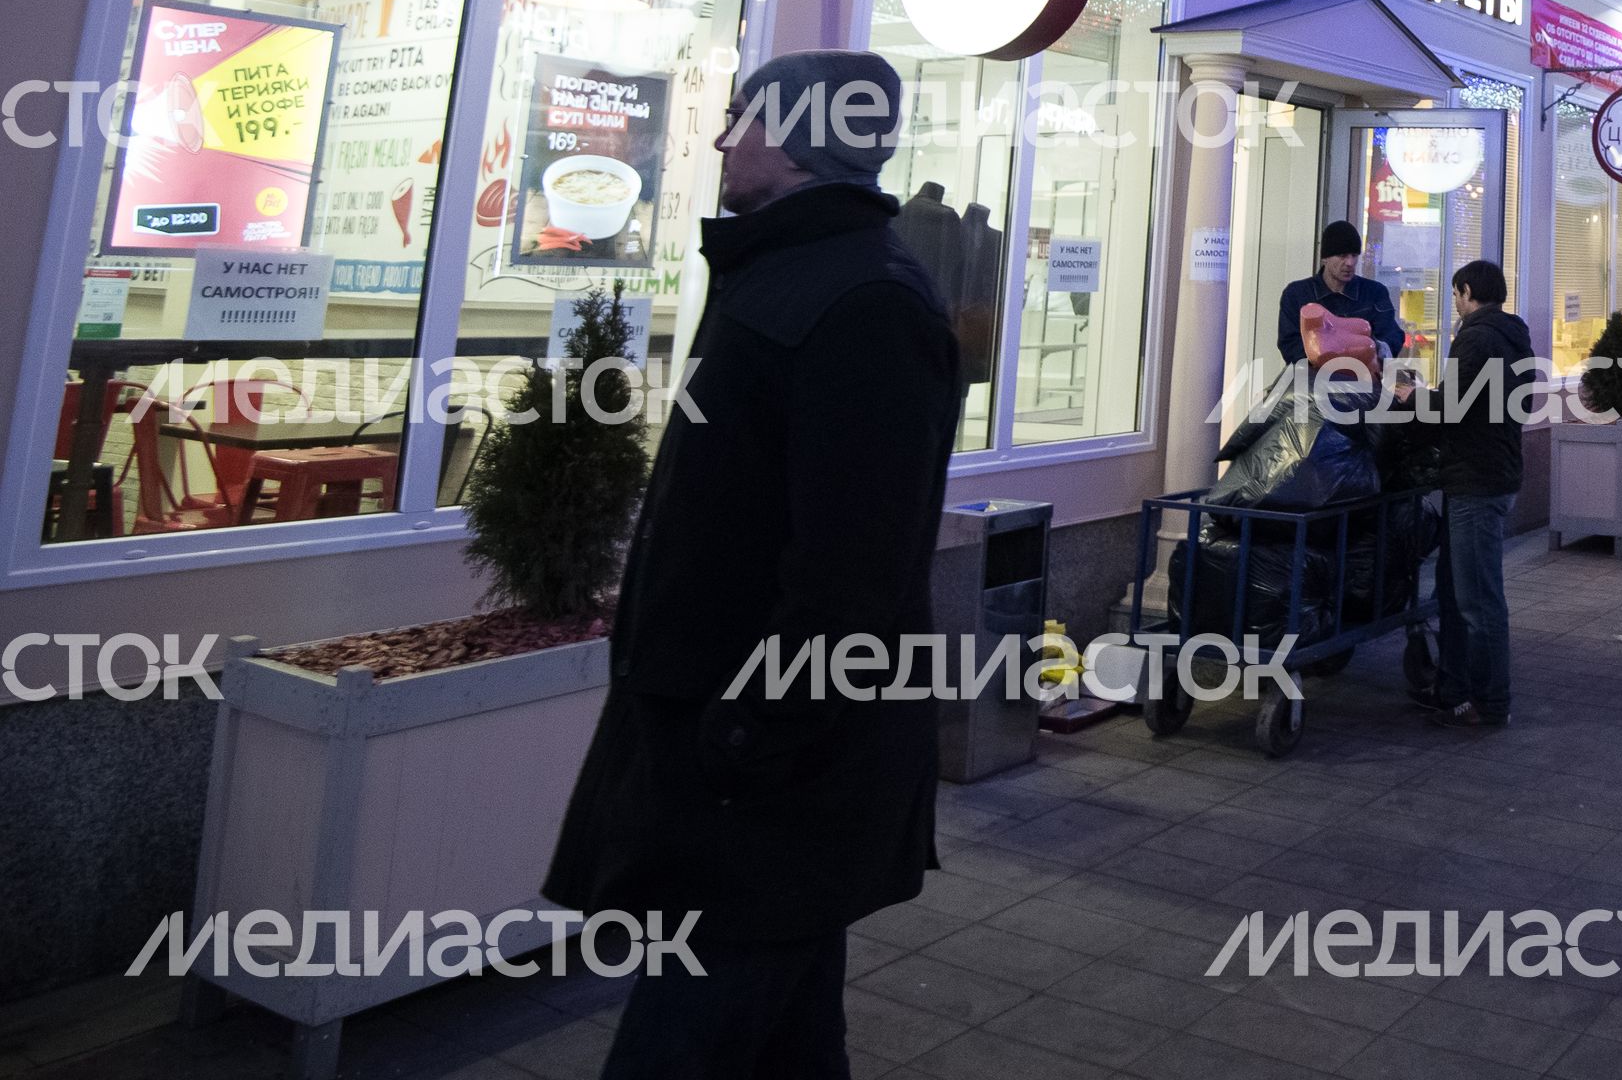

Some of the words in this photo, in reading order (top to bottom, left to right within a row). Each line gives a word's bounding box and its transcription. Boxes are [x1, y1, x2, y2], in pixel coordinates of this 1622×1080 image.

[164, 38, 222, 56] ЦЕНА
[389, 47, 424, 69] PITA
[234, 63, 288, 82] ПИТА
[217, 78, 309, 102] ТЕРИЯКИ
[353, 78, 398, 95] COMING
[401, 75, 432, 91] BACK
[554, 74, 639, 100] ПОПРОБУЙ
[227, 104, 240, 119] И
[246, 95, 305, 115] КОФЕ
[551, 89, 588, 109] НАШ
[551, 110, 584, 126] СУП
[586, 113, 625, 129] ЧИЛИ
[171, 212, 208, 225] 12:00
[1066, 246, 1079, 254] НАС
[1080, 246, 1092, 254] НЕТ
[222, 261, 234, 274] У
[238, 262, 273, 275] НАС
[276, 263, 308, 275] НЕТ
[201, 285, 320, 299] САМОСТРОЯ!!
